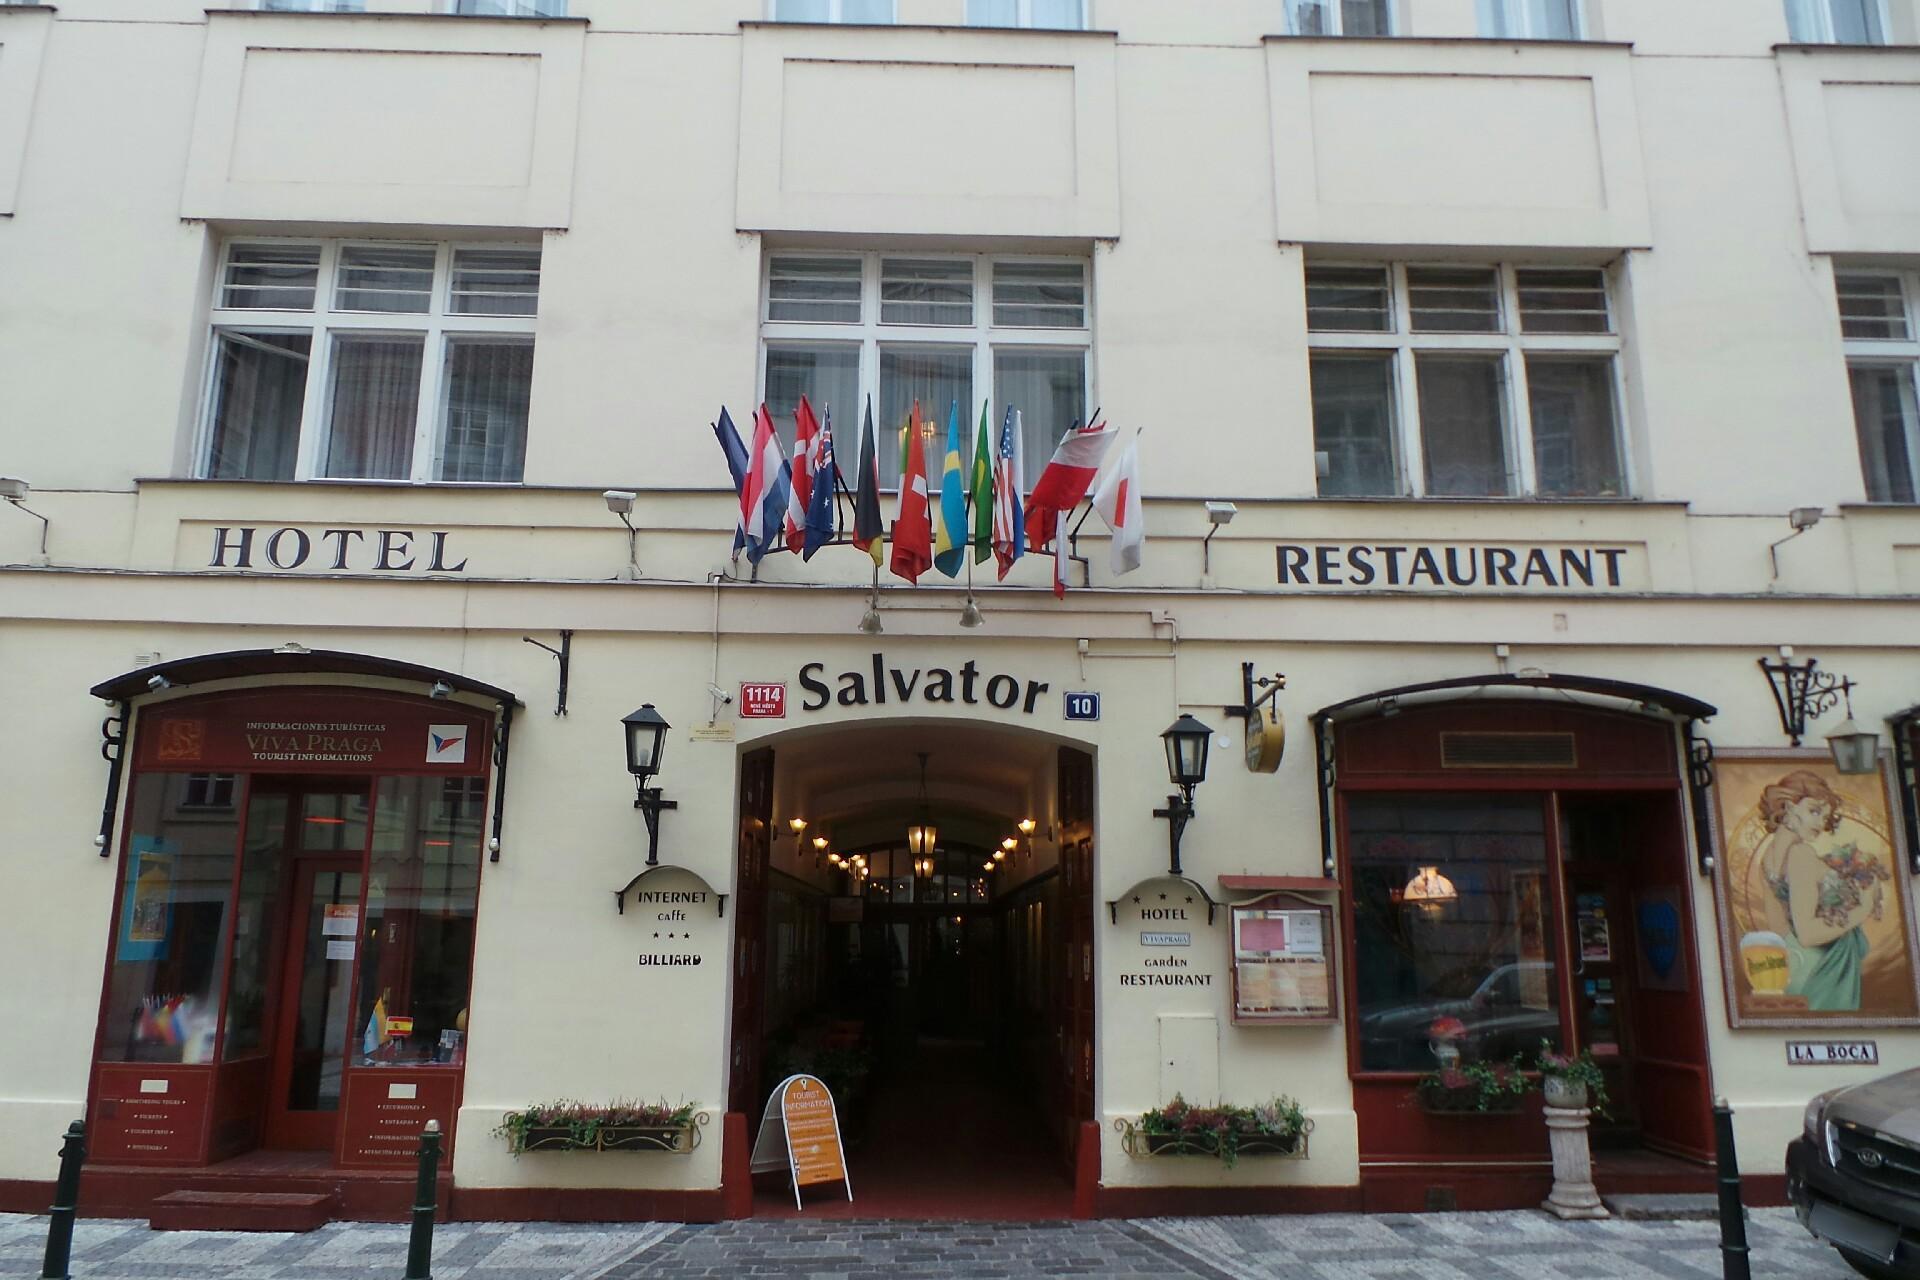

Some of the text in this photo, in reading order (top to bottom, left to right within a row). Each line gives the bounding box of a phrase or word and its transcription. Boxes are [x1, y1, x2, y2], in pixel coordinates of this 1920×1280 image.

[207, 527, 468, 572] HOTEL
[1275, 545, 1627, 587] RESTAURANT
[798, 652, 1049, 714] Salvator
[746, 687, 780, 702] 1114
[1072, 698, 1091, 715] 10
[246, 722, 327, 731] INFORMACIONES
[245, 734, 382, 752] VIVA PRAGA
[252, 752, 373, 762] TOURIST INFORMATIONS
[638, 891, 707, 903] INTERNET
[1141, 908, 1188, 920] HOTEL
[639, 954, 701, 966] BILLIARD
[1120, 974, 1213, 986] RESTAURANT
[1794, 1046, 1869, 1059] LA BOCA
